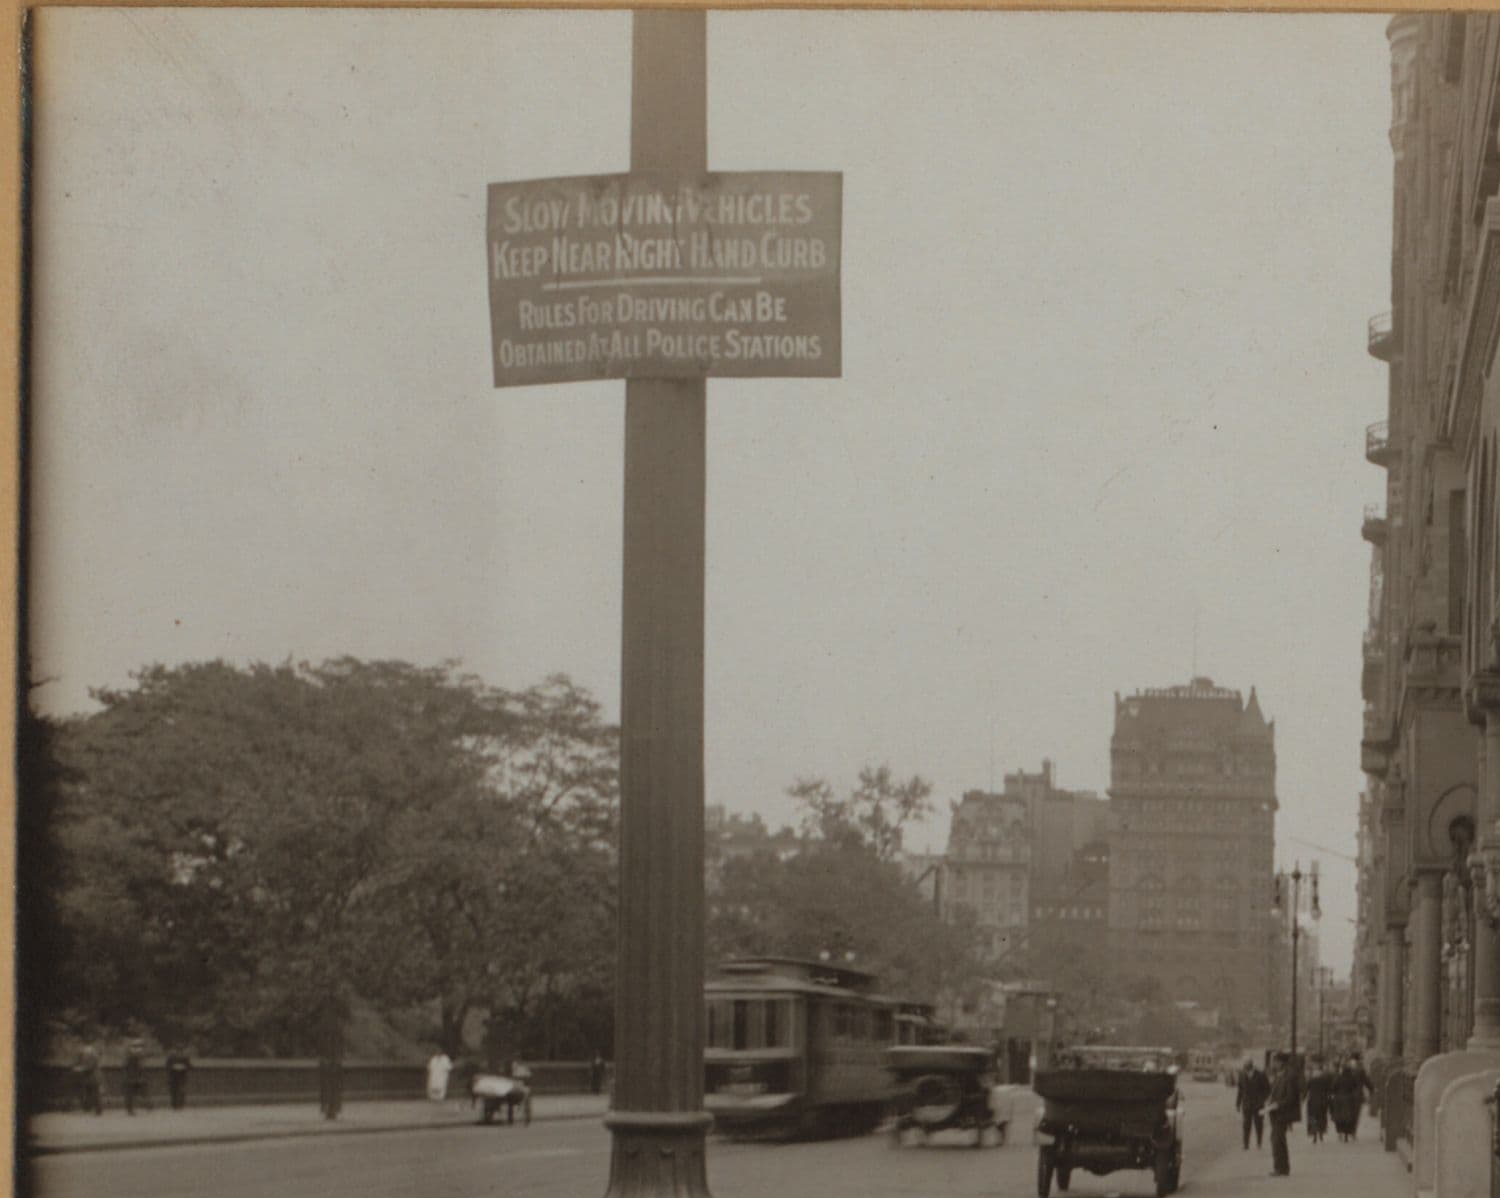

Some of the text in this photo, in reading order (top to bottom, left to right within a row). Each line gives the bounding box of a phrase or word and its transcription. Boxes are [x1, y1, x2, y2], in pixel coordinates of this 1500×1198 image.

[503, 195, 570, 233] SLOW
[493, 230, 826, 280] KEEP NEAR RIGHT HAND CURB
[518, 290, 787, 330] RULES FOR DRIVING CAN BE
[499, 327, 822, 368] OBTAINED AT ALL POLICE STATIONS
